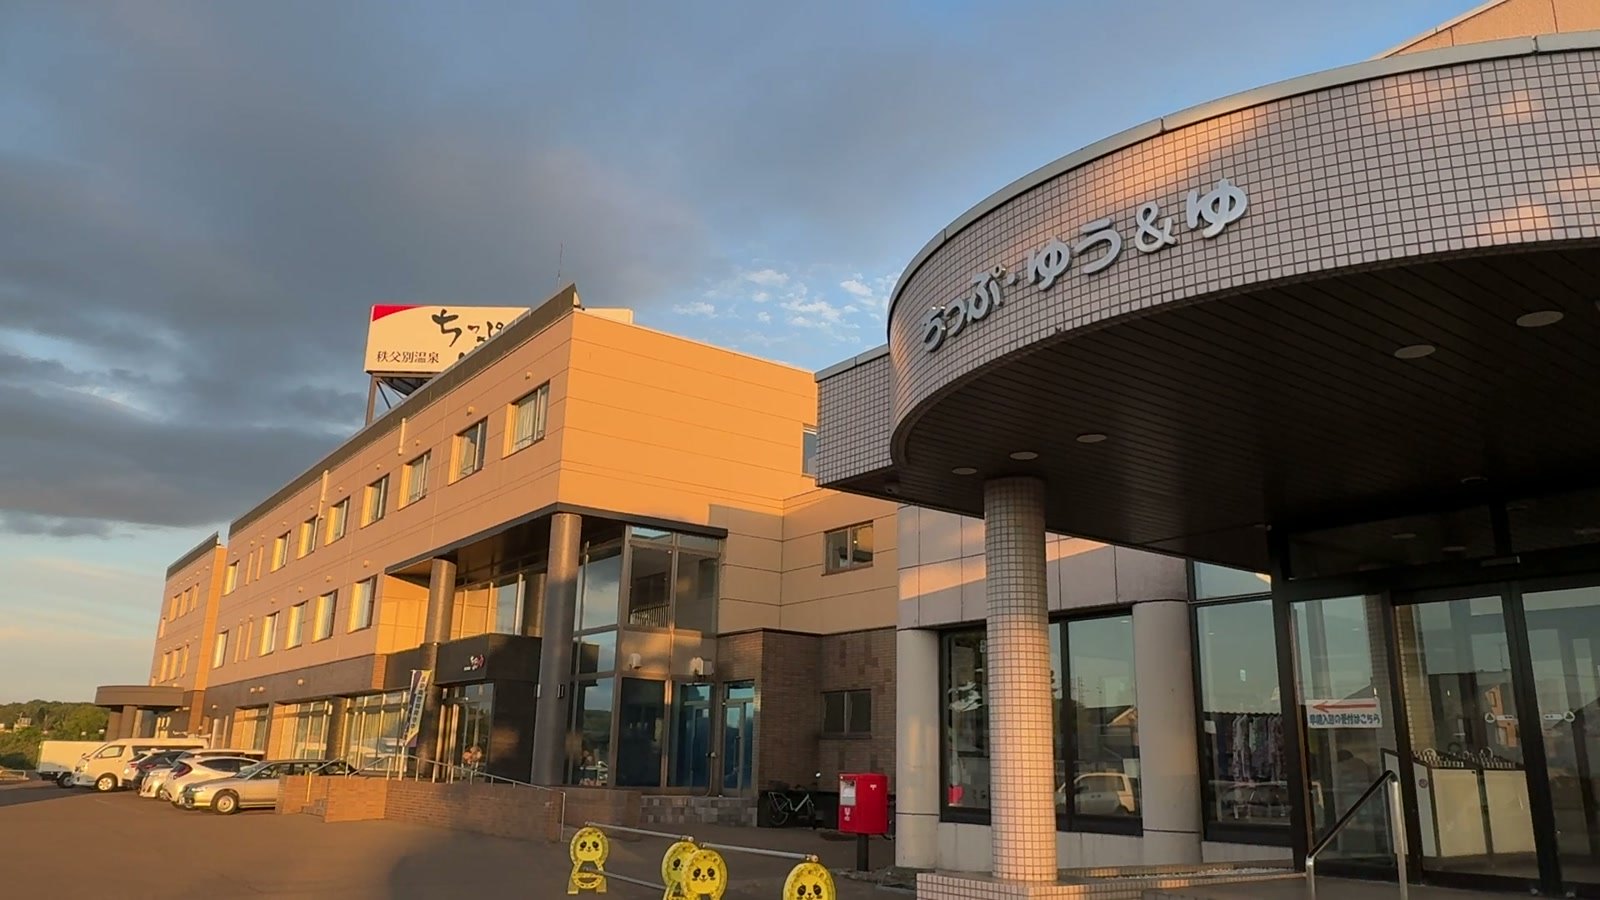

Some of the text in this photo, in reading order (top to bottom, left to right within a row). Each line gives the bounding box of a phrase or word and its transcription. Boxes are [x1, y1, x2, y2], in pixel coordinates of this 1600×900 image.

[377, 351, 439, 363] 秩父別温泉
